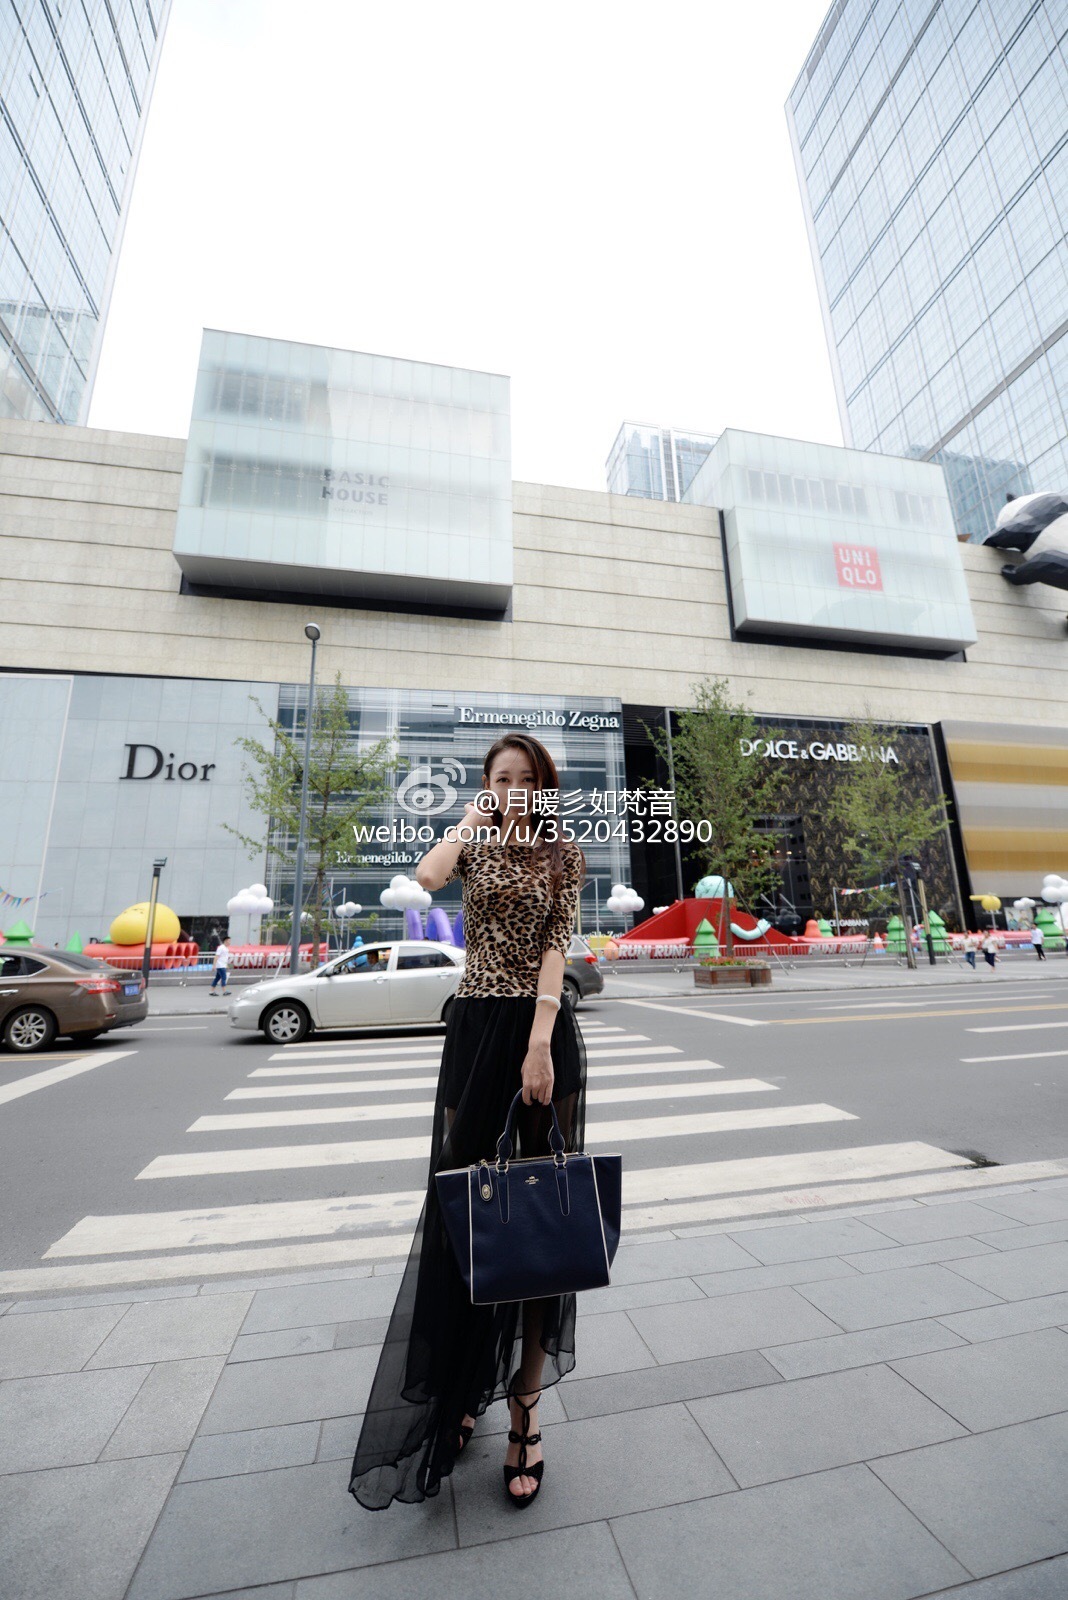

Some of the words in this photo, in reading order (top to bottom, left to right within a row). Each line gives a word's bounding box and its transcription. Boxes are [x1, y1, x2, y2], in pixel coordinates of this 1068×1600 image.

[324, 469, 390, 488] BASIC
[322, 486, 388, 506] HOUSE
[839, 548, 871, 567] UNI
[842, 567, 877, 585] QLO
[458, 706, 566, 729] Ermenegildo
[569, 710, 620, 732] Zegna
[119, 743, 216, 781] Dior
